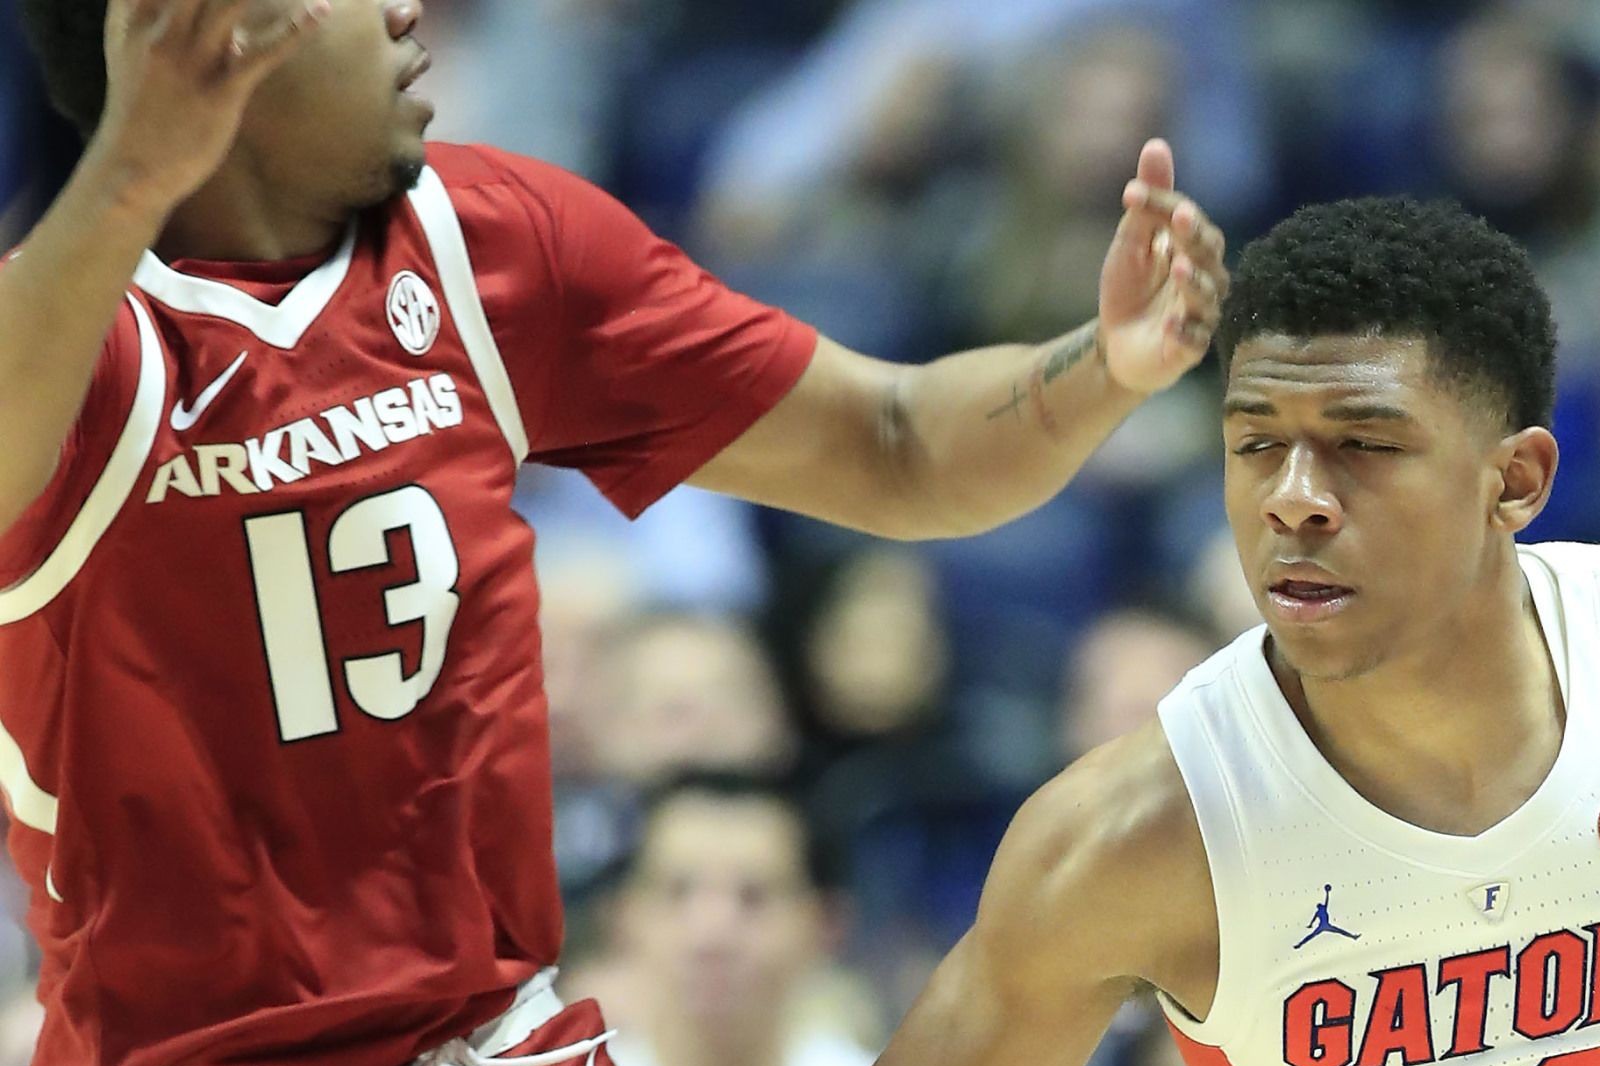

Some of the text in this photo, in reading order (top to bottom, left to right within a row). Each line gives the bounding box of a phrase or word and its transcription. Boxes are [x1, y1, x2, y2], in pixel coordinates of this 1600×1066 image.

[145, 372, 463, 503] ARKANSAS
[242, 483, 461, 744] 13
[1482, 884, 1501, 912] F
